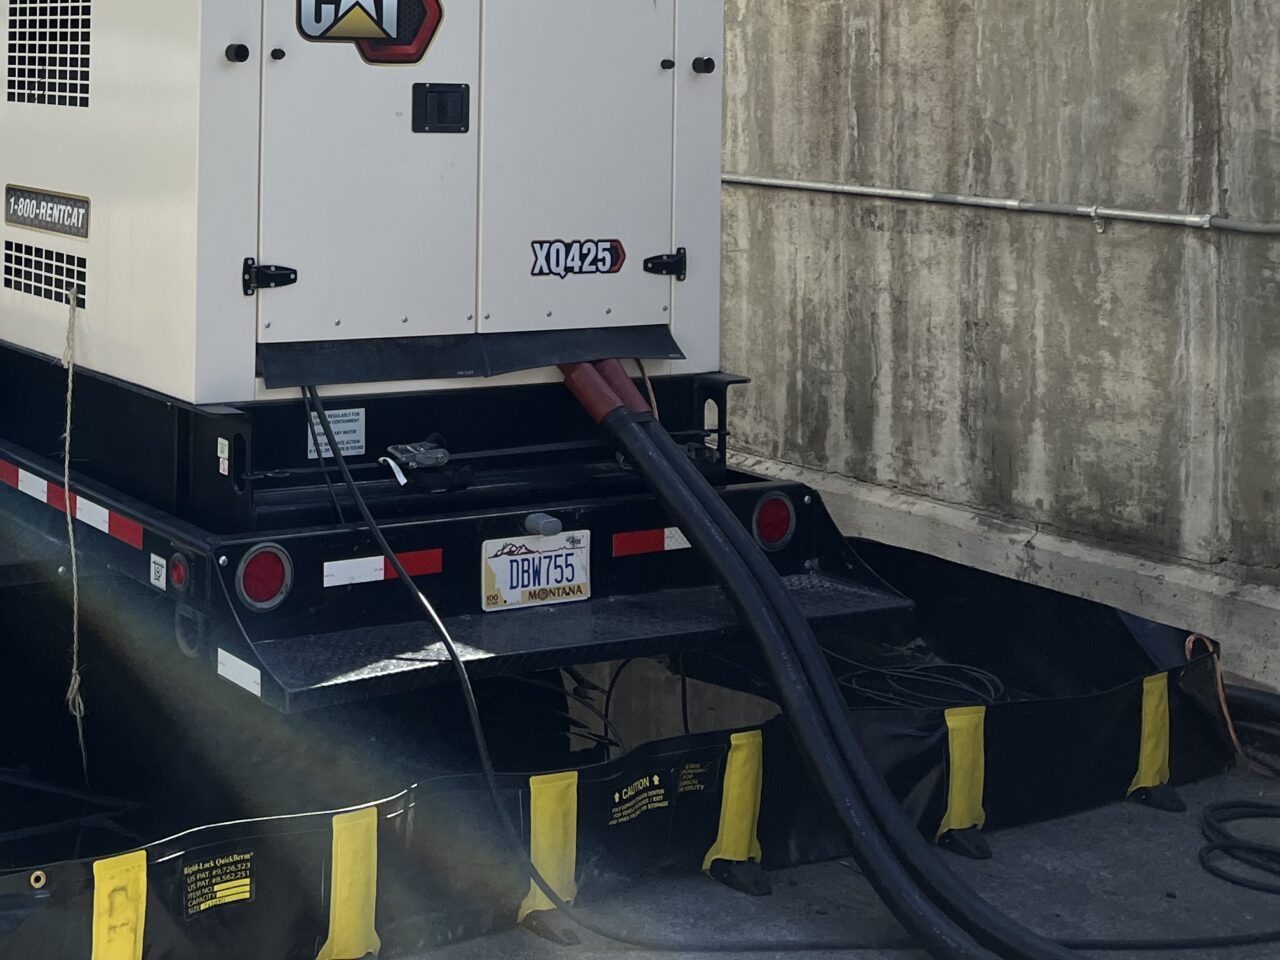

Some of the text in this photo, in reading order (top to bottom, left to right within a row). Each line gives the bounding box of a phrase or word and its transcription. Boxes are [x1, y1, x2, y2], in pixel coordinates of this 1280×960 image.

[9, 196, 86, 228] 1-800-RENTCAT
[532, 241, 612, 278] XQ425
[509, 552, 575, 590] DBW755
[528, 585, 583, 601] MONTANA
[622, 776, 649, 799] CAUTION
